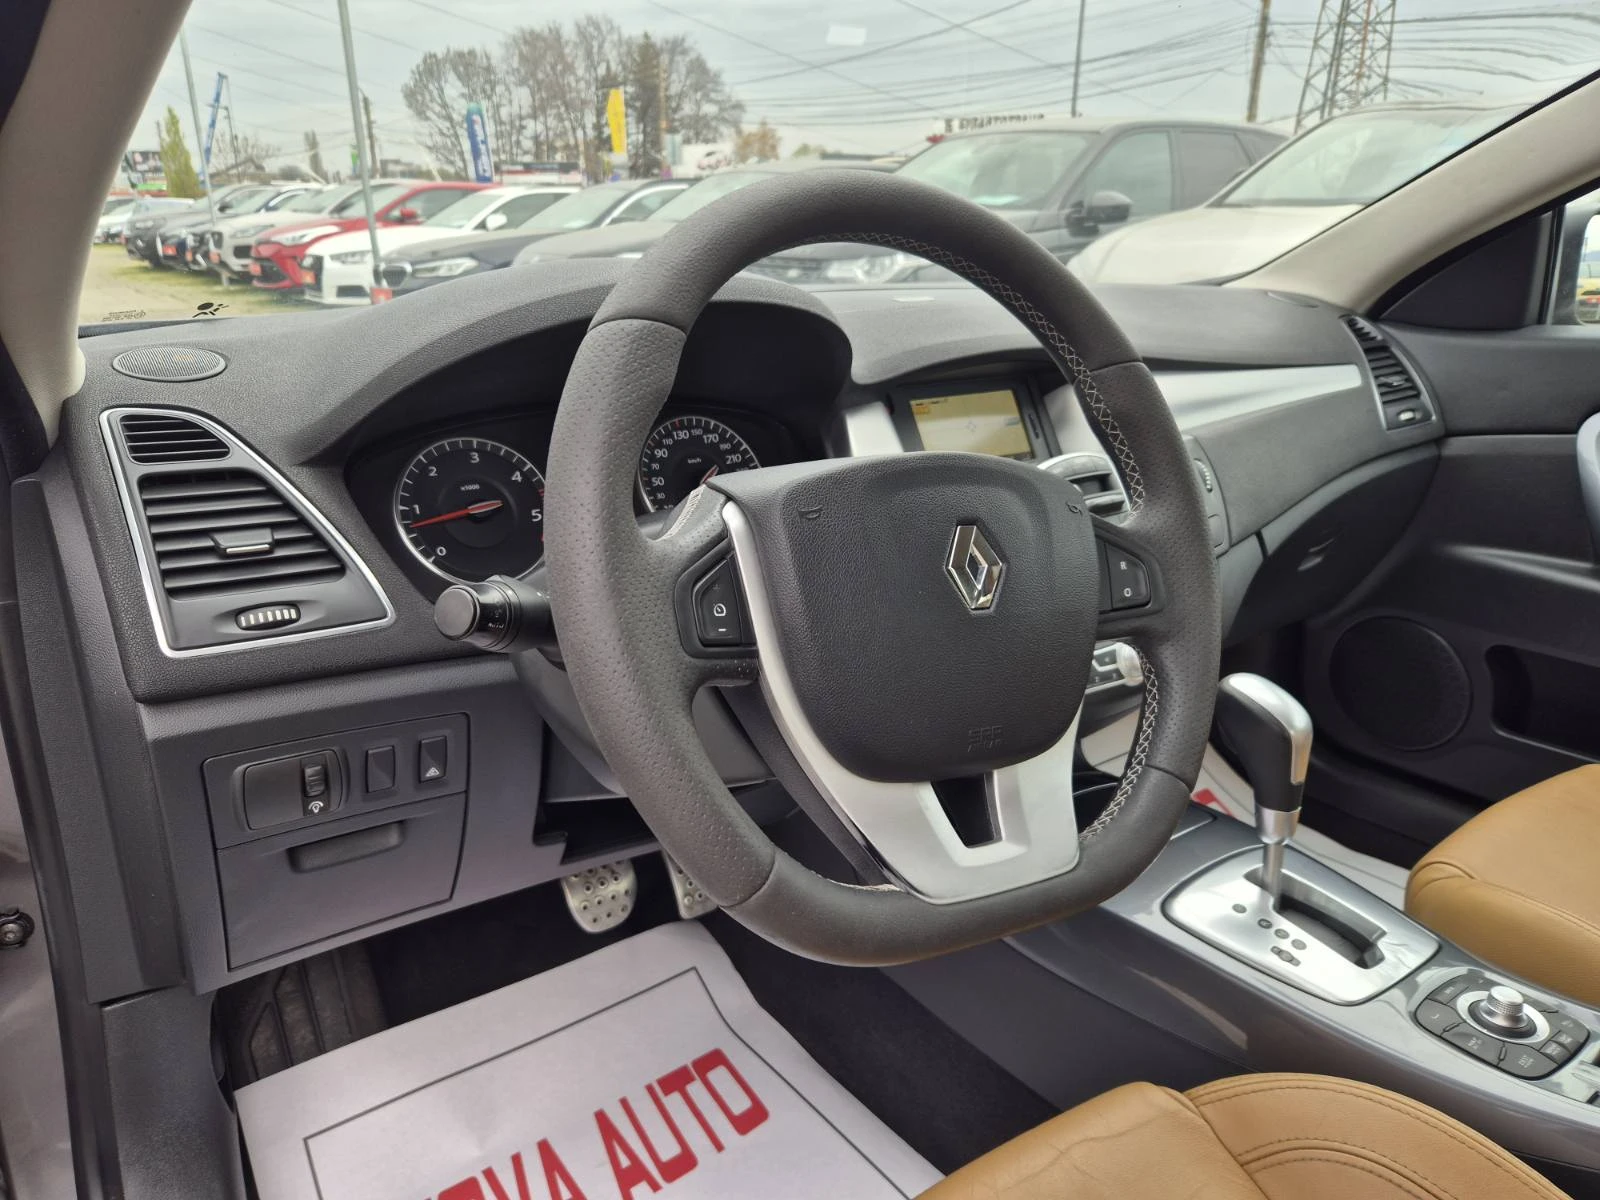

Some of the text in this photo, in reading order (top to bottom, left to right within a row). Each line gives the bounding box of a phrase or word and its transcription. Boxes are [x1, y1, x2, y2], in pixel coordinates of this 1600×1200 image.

[673, 430, 689, 440] 130
[702, 434, 719, 444] 170
[470, 452, 480, 463] 3
[654, 449, 668, 458] 90
[725, 453, 742, 464] 210
[428, 466, 438, 476] 2
[511, 471, 522, 483] 4
[651, 477, 665, 487] 50
[413, 505, 421, 514] 1
[531, 509, 542, 522] 5
[436, 546, 447, 556] 0
[593, 1047, 770, 1200] AUTO
